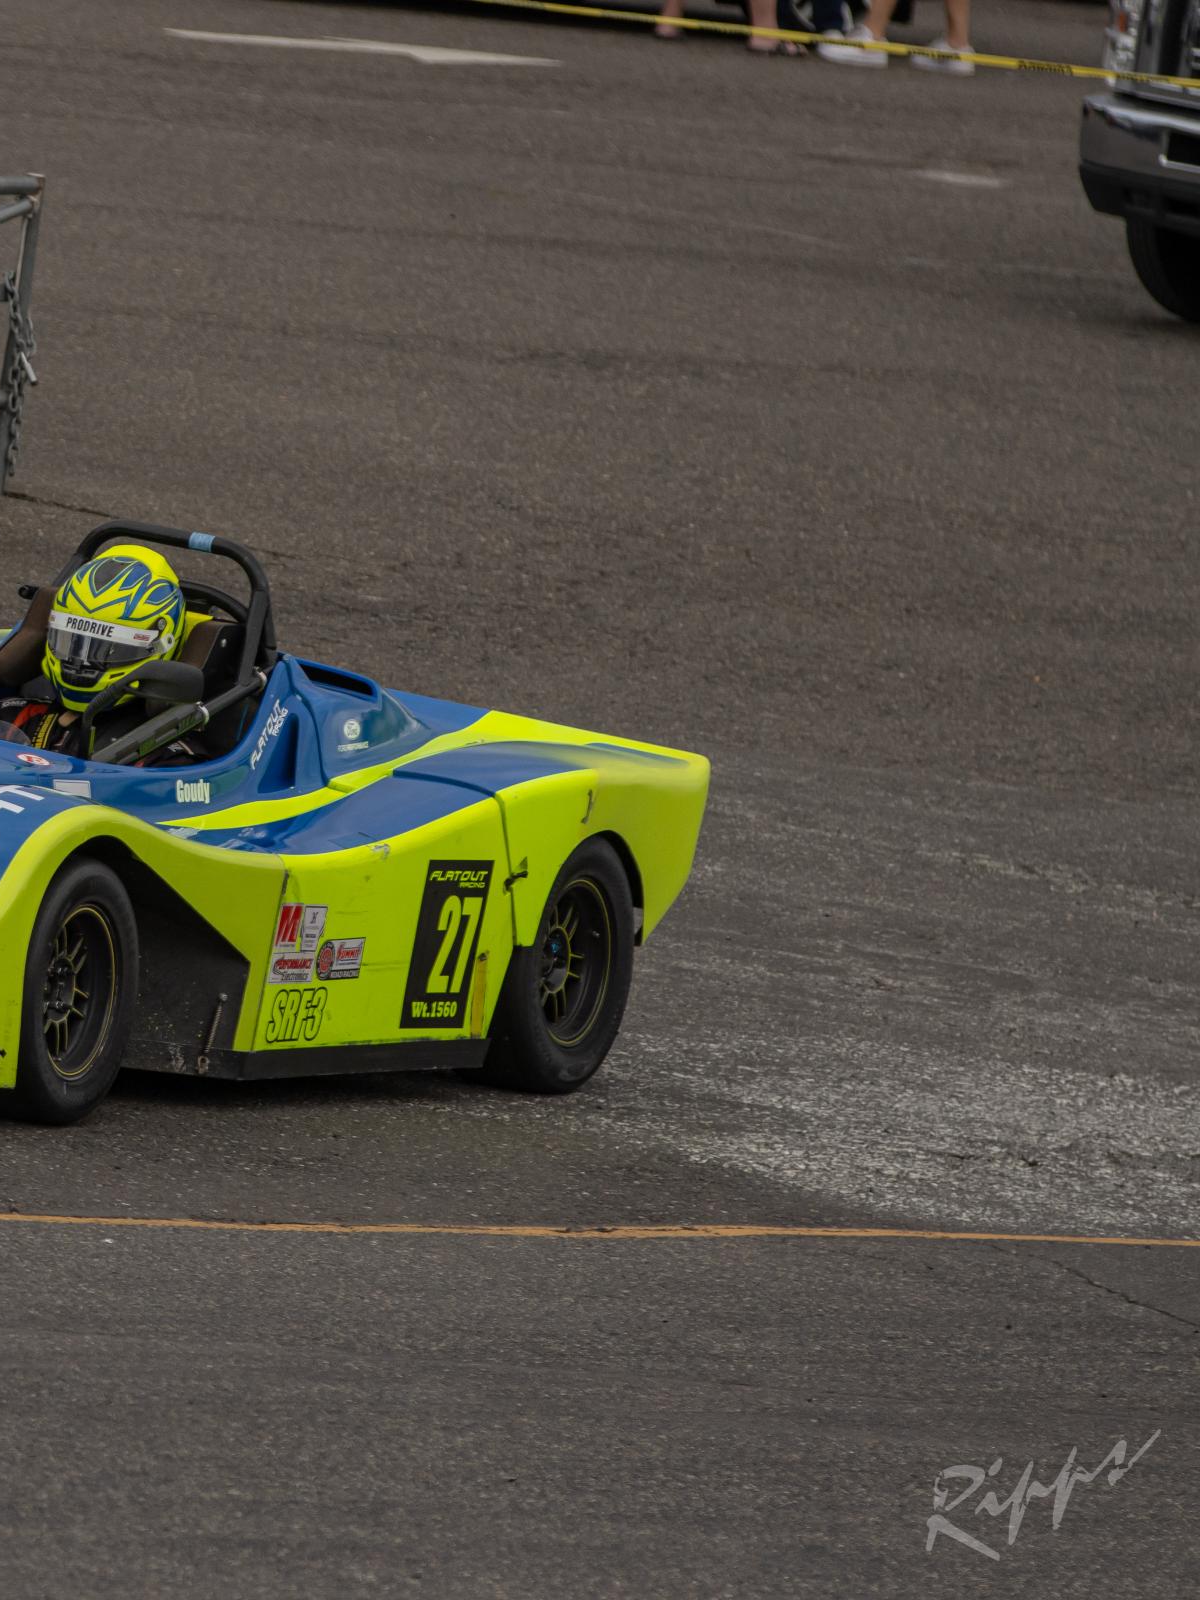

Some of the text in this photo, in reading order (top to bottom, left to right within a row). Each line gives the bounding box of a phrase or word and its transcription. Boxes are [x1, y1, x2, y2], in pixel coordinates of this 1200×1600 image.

[66, 616, 115, 638] PRODRIVE
[176, 779, 210, 804] Goudy
[429, 871, 489, 881] FLATOUT
[426, 895, 483, 994] 27
[266, 986, 328, 1044] SRF3
[411, 1001, 458, 1018] Wt.1560
